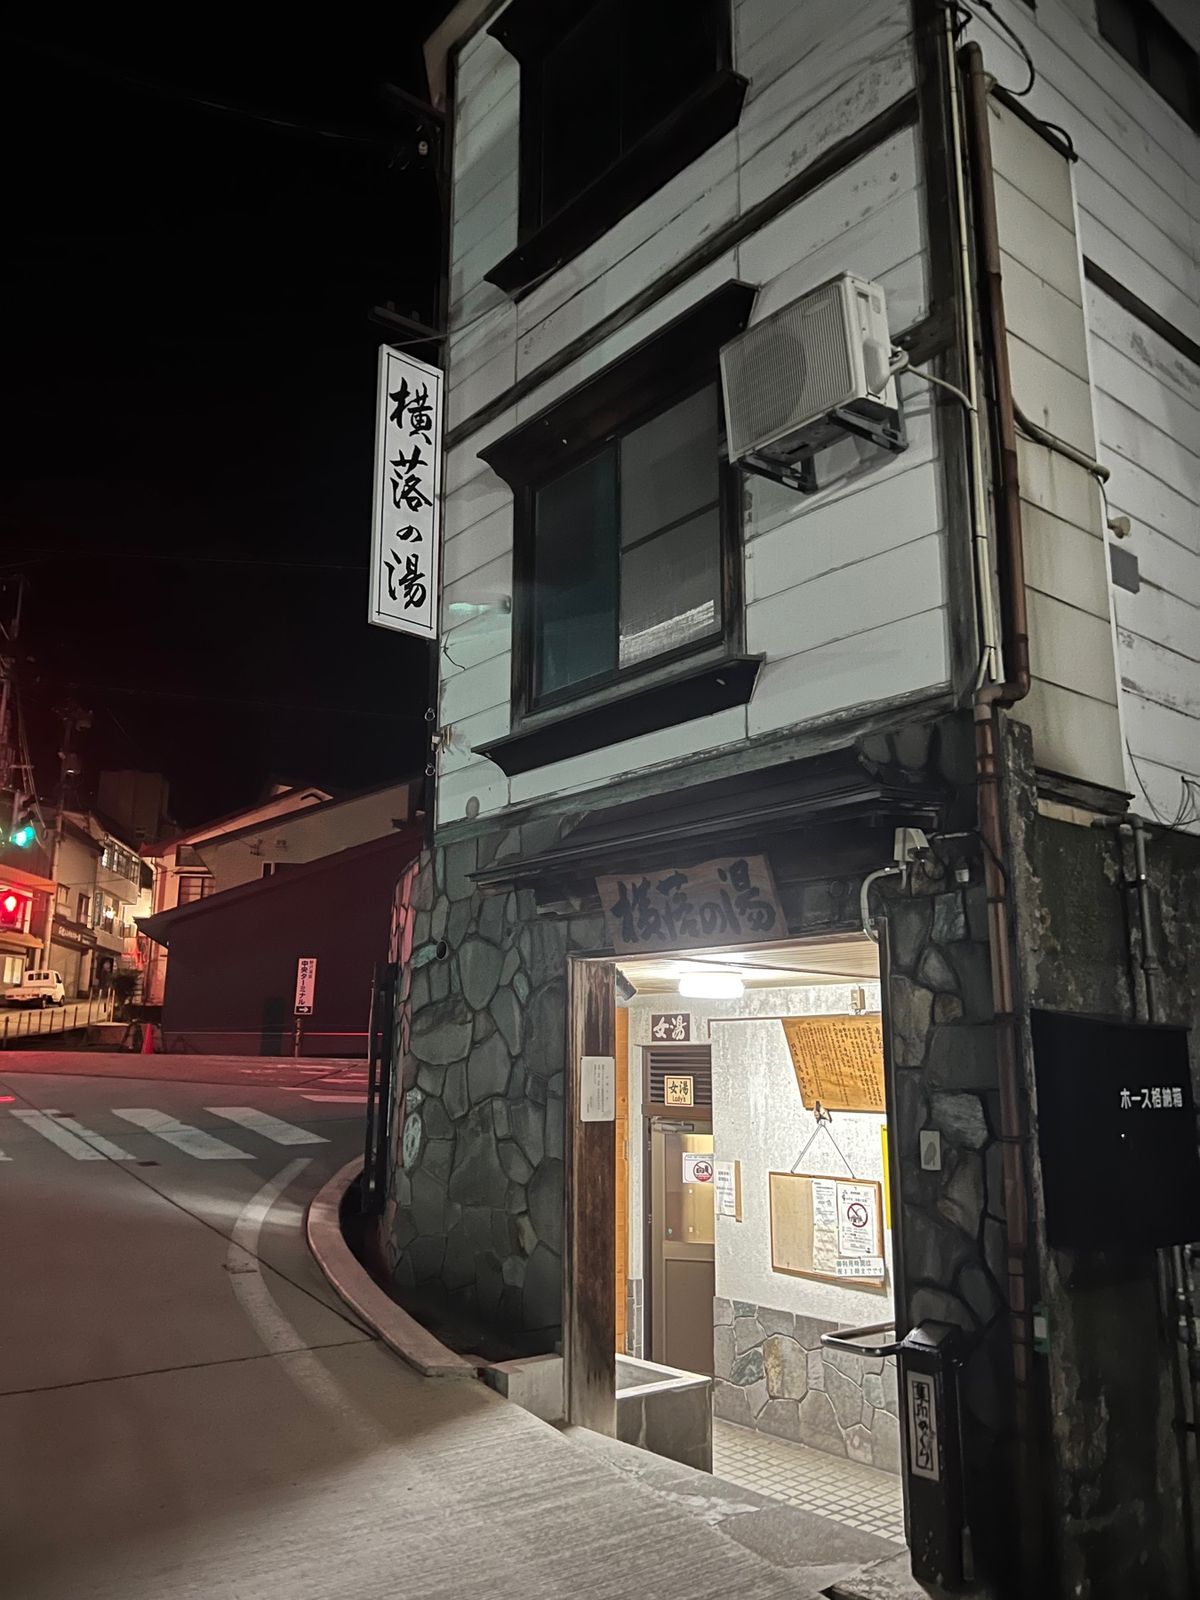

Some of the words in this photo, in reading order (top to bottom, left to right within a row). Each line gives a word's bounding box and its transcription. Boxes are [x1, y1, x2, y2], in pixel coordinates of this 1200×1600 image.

[384, 377, 433, 609] 横落の湯
[298, 960, 309, 1005] 中央ターミナル
[653, 1015, 687, 1041] 女湯
[668, 1080, 689, 1096] 女湯
[1120, 1087, 1183, 1109] ホース格納箱
